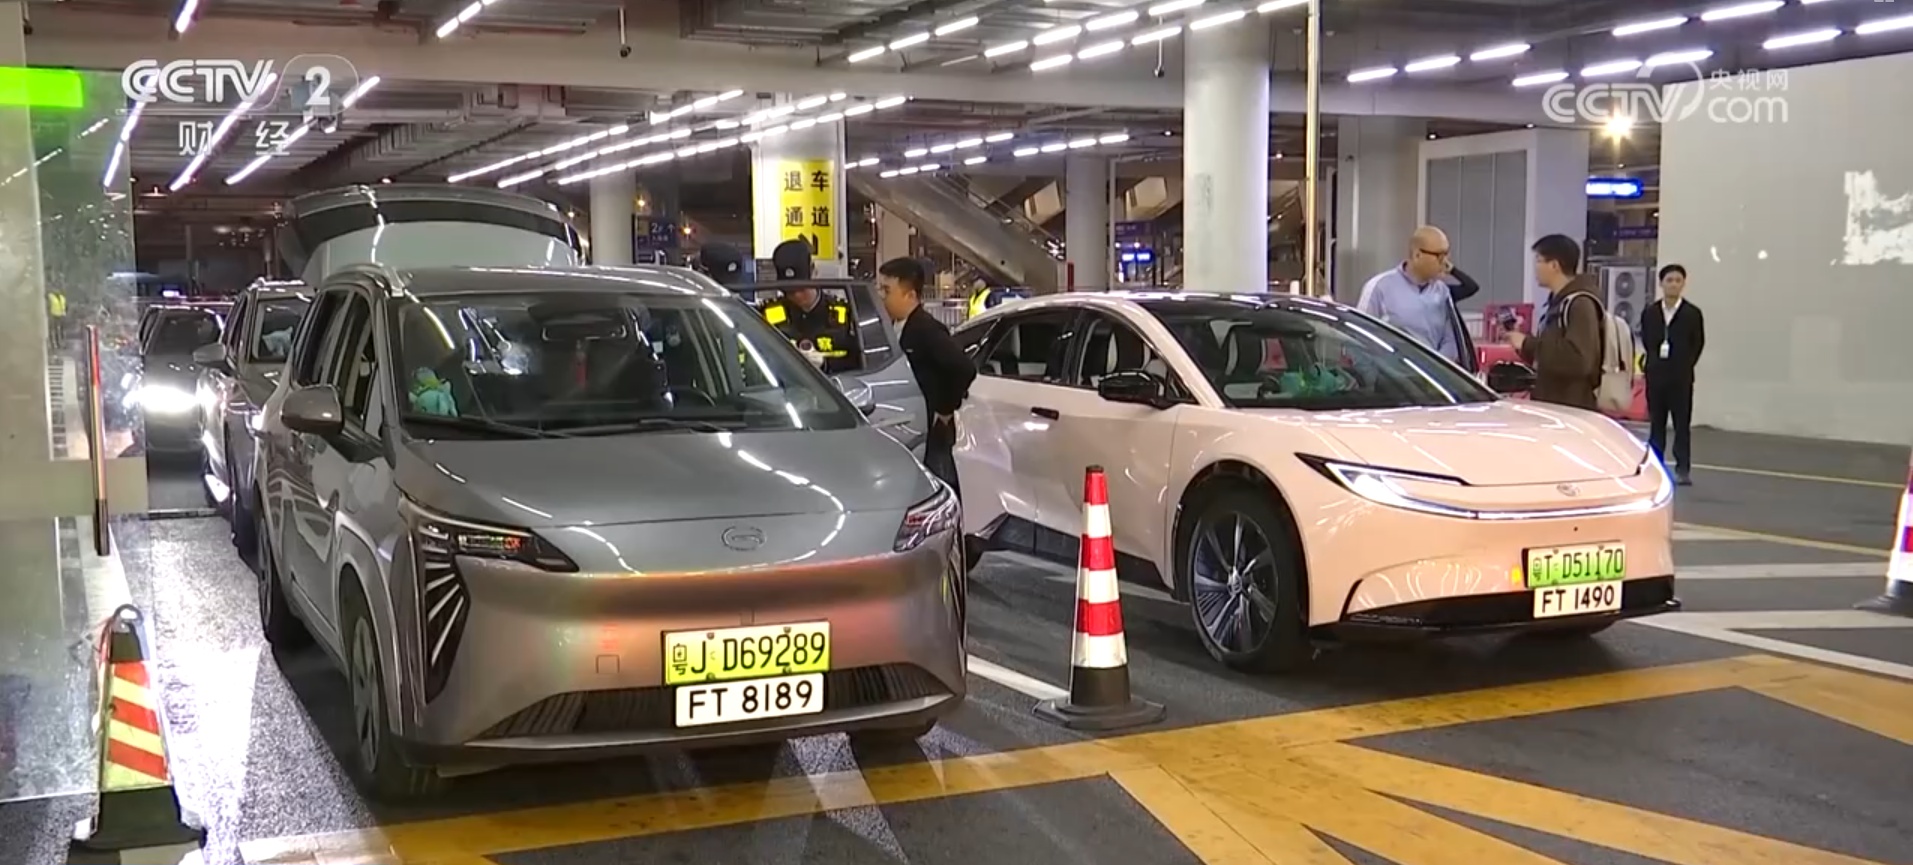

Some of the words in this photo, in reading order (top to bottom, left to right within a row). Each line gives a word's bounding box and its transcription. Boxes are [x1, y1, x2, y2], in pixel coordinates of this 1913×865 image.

[784, 170, 830, 192] 退车
[785, 206, 830, 227] 通道
[1563, 548, 1624, 578] D51170
[1542, 589, 1566, 613] FT
[1574, 584, 1615, 610] 1490
[723, 632, 825, 671] D69289
[690, 688, 728, 719] FT
[742, 680, 812, 713] 8189
